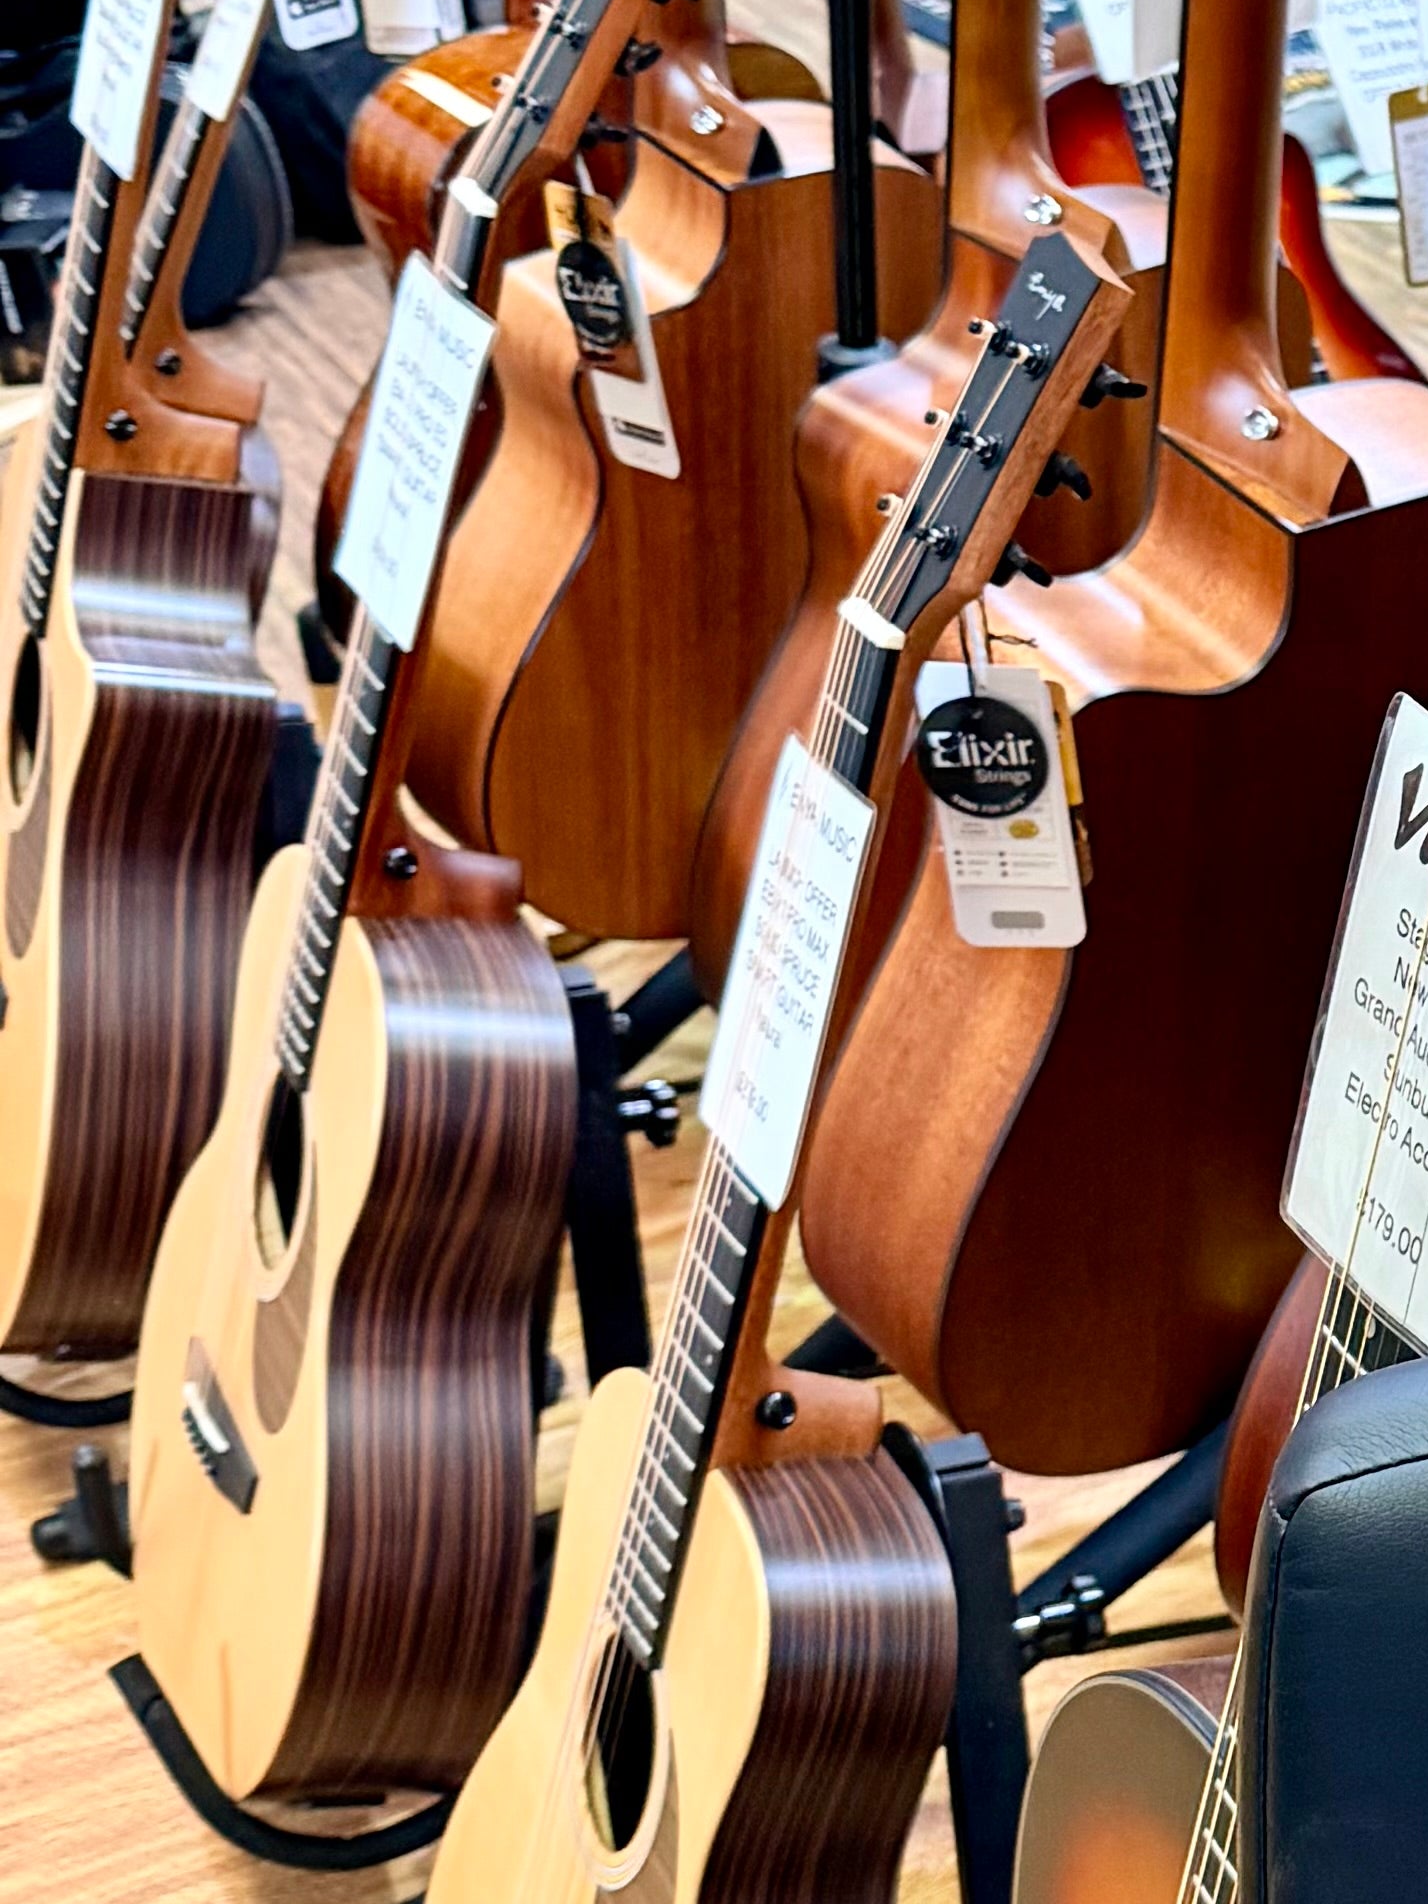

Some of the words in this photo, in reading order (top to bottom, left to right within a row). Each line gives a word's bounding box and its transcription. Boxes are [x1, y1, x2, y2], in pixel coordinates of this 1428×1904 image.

[927, 730, 1035, 769] Elixir
[973, 768, 1033, 787] Strings
[1354, 977, 1403, 1038] Grand
[1393, 955, 1428, 1008] New
[1343, 1071, 1400, 1142] Elecro
